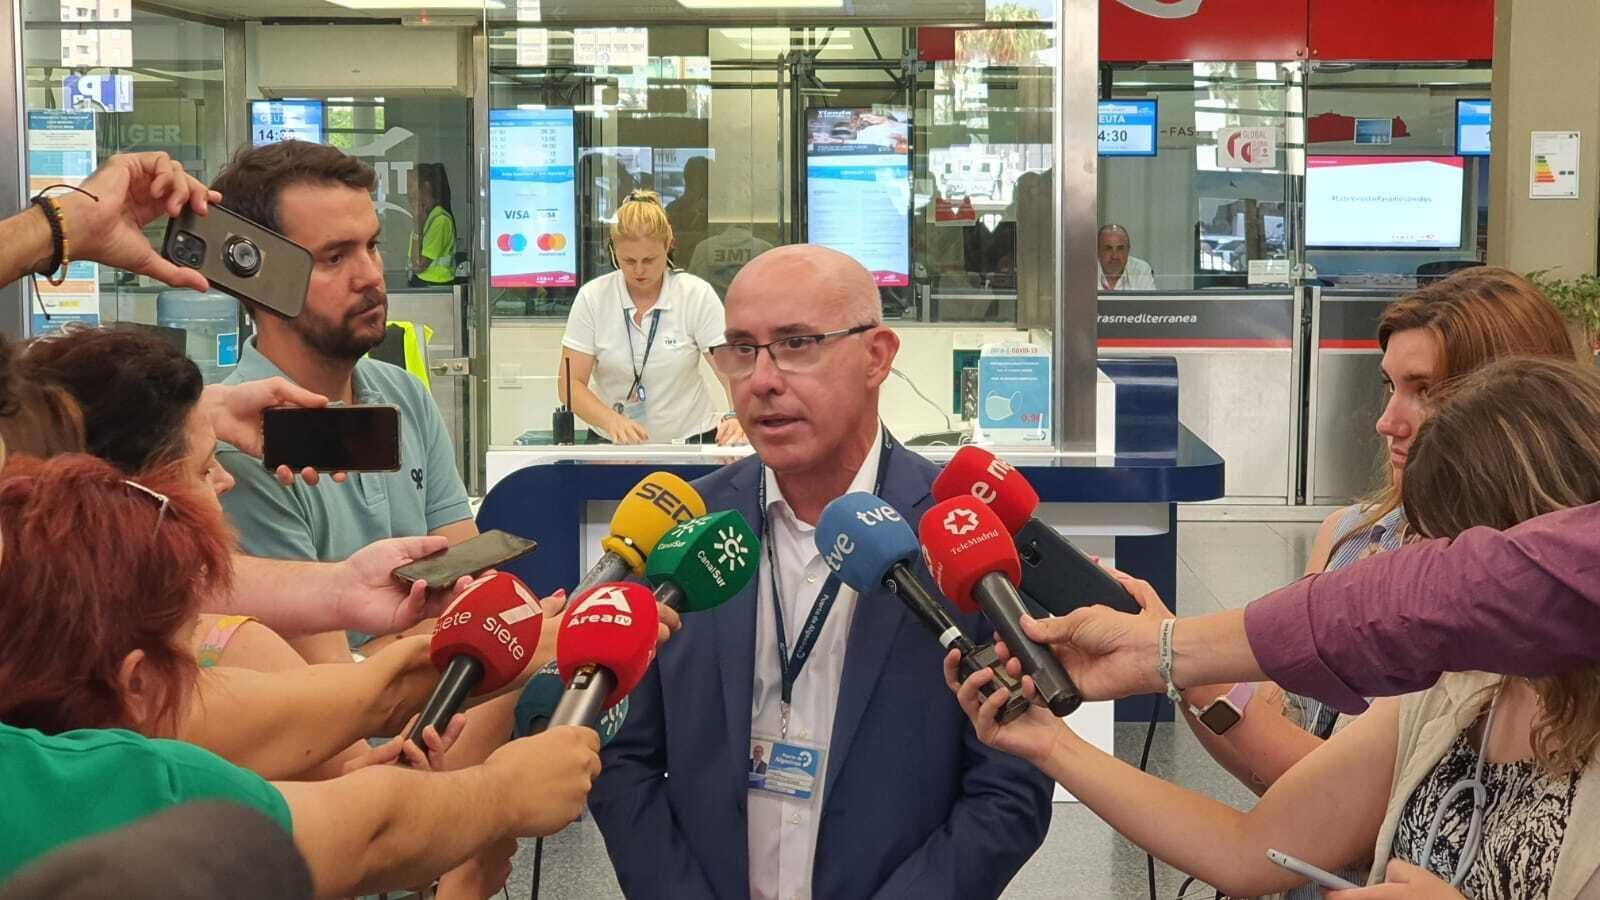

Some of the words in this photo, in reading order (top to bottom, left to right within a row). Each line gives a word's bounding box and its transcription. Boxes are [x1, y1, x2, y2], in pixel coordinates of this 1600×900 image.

[504, 209, 530, 220] VISA
[856, 504, 901, 527] tve
[826, 533, 855, 572] tve
[951, 529, 999, 556] TeleMadrid
[697, 550, 727, 588] CanalSur
[482, 616, 525, 661] siete
